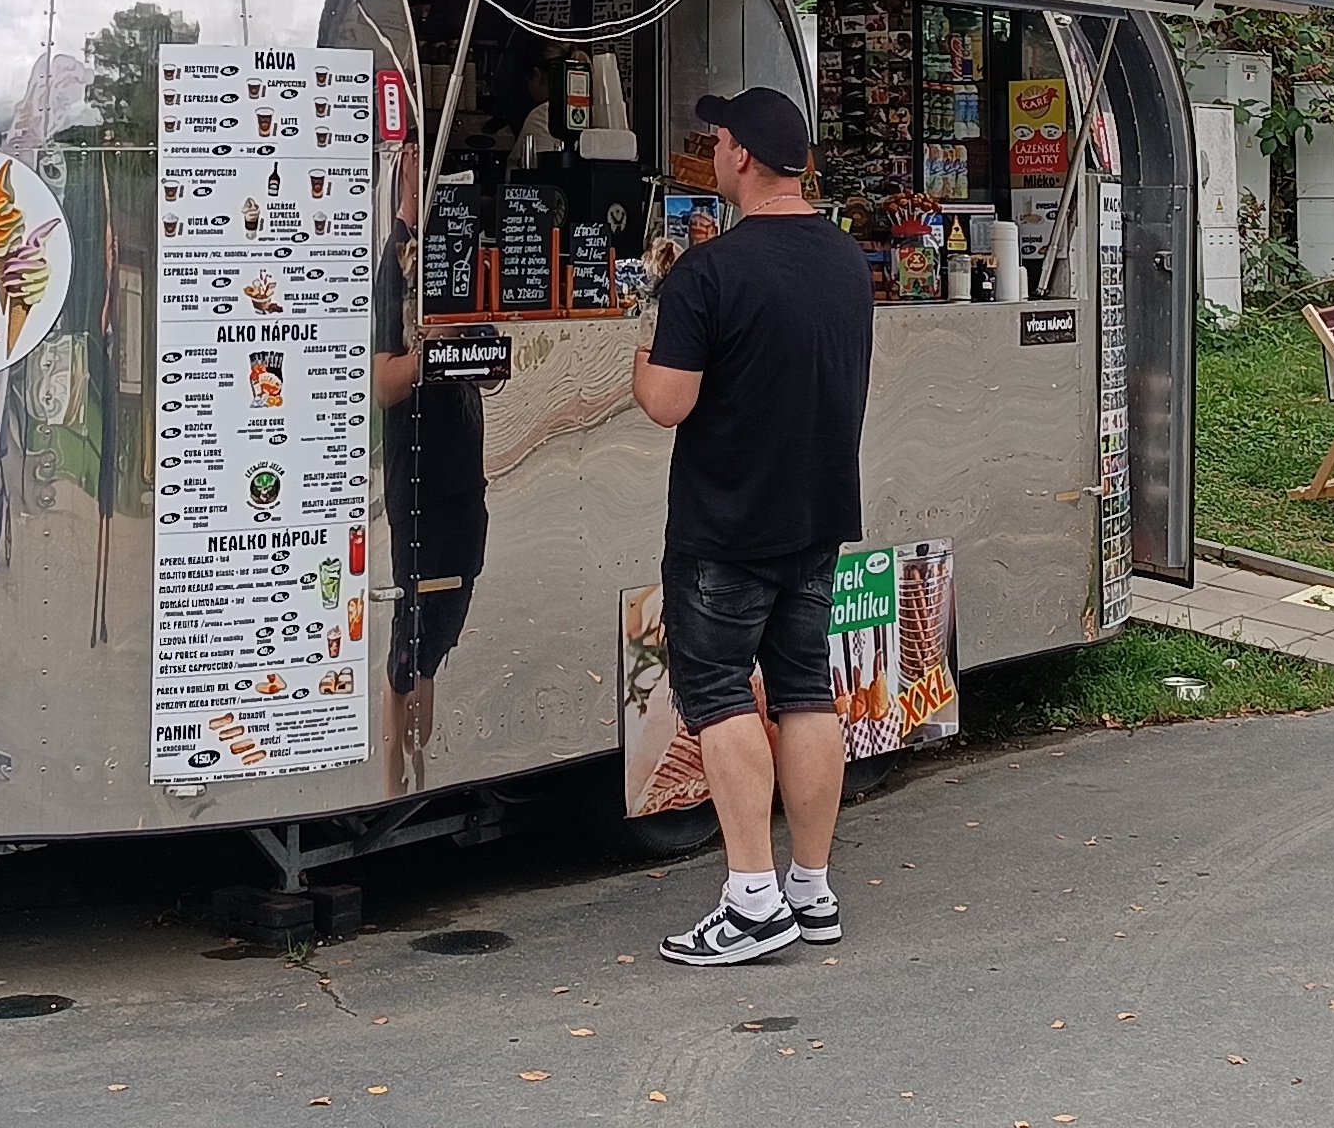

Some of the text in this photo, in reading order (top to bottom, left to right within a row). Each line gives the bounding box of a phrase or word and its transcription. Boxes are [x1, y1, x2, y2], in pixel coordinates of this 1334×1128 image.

[255, 48, 296, 70] KÁVA
[267, 79, 306, 88] CAPPUCCINO
[184, 95, 218, 103] ESPRESSO
[1022, 94, 1049, 110] KARE
[185, 117, 217, 125] ESPRESSO
[281, 117, 298, 126] LATTE
[1015, 141, 1061, 154] LÁZEŇSKÉ
[1016, 155, 1059, 165] OPLATKY
[163, 268, 198, 276] ESPRESSO
[163, 295, 199, 303] ESPRESSO
[217, 320, 318, 343] ALKO NÁPOJE
[428, 344, 507, 363] SMĚR NÁKUPU
[208, 528, 328, 552] NEALKO NÁPOJE
[159, 571, 186, 580] MOJITO
[834, 561, 865, 592] rek
[159, 585, 186, 594] MOJITO
[159, 621, 171, 630] ICE
[899, 665, 954, 737] XXL
[156, 723, 202, 742] PANINI
